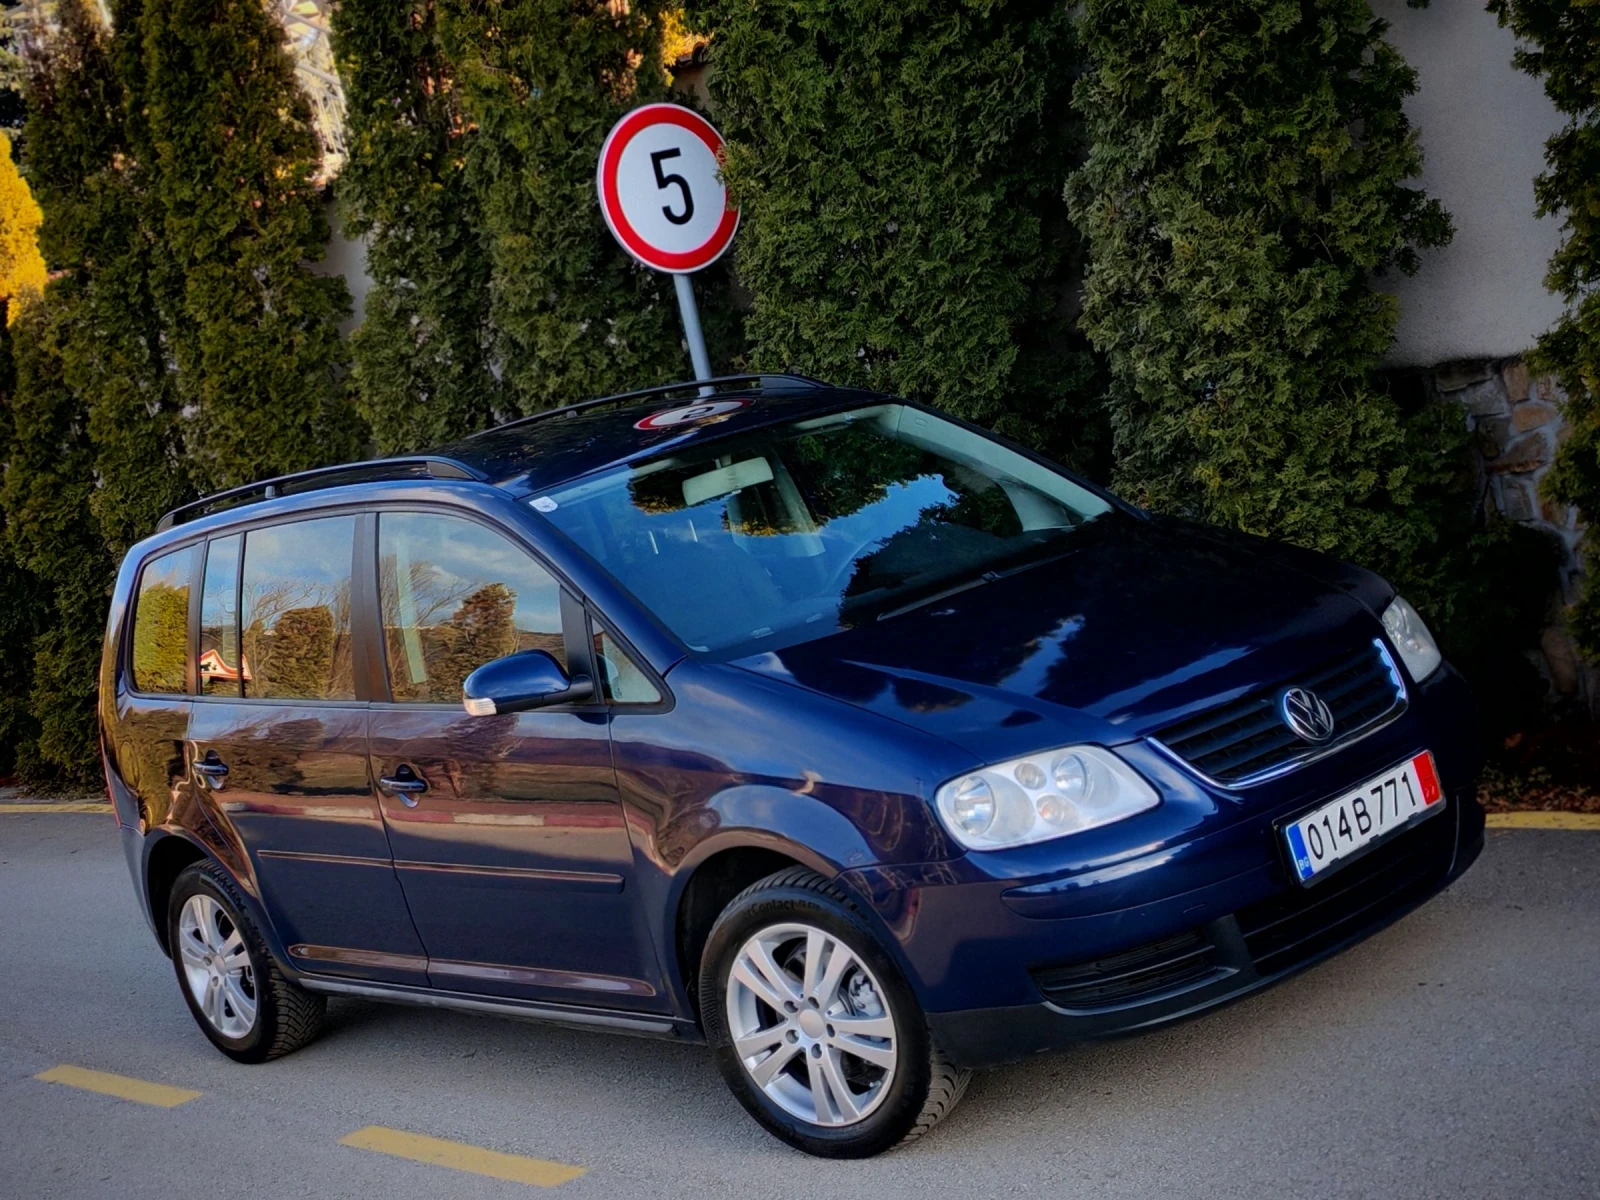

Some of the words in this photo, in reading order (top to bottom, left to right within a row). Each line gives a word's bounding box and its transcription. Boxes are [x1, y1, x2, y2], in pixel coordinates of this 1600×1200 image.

[650, 147, 694, 225] 5
[1307, 772, 1416, 861] 014B771
[1299, 857, 1310, 871] BG
